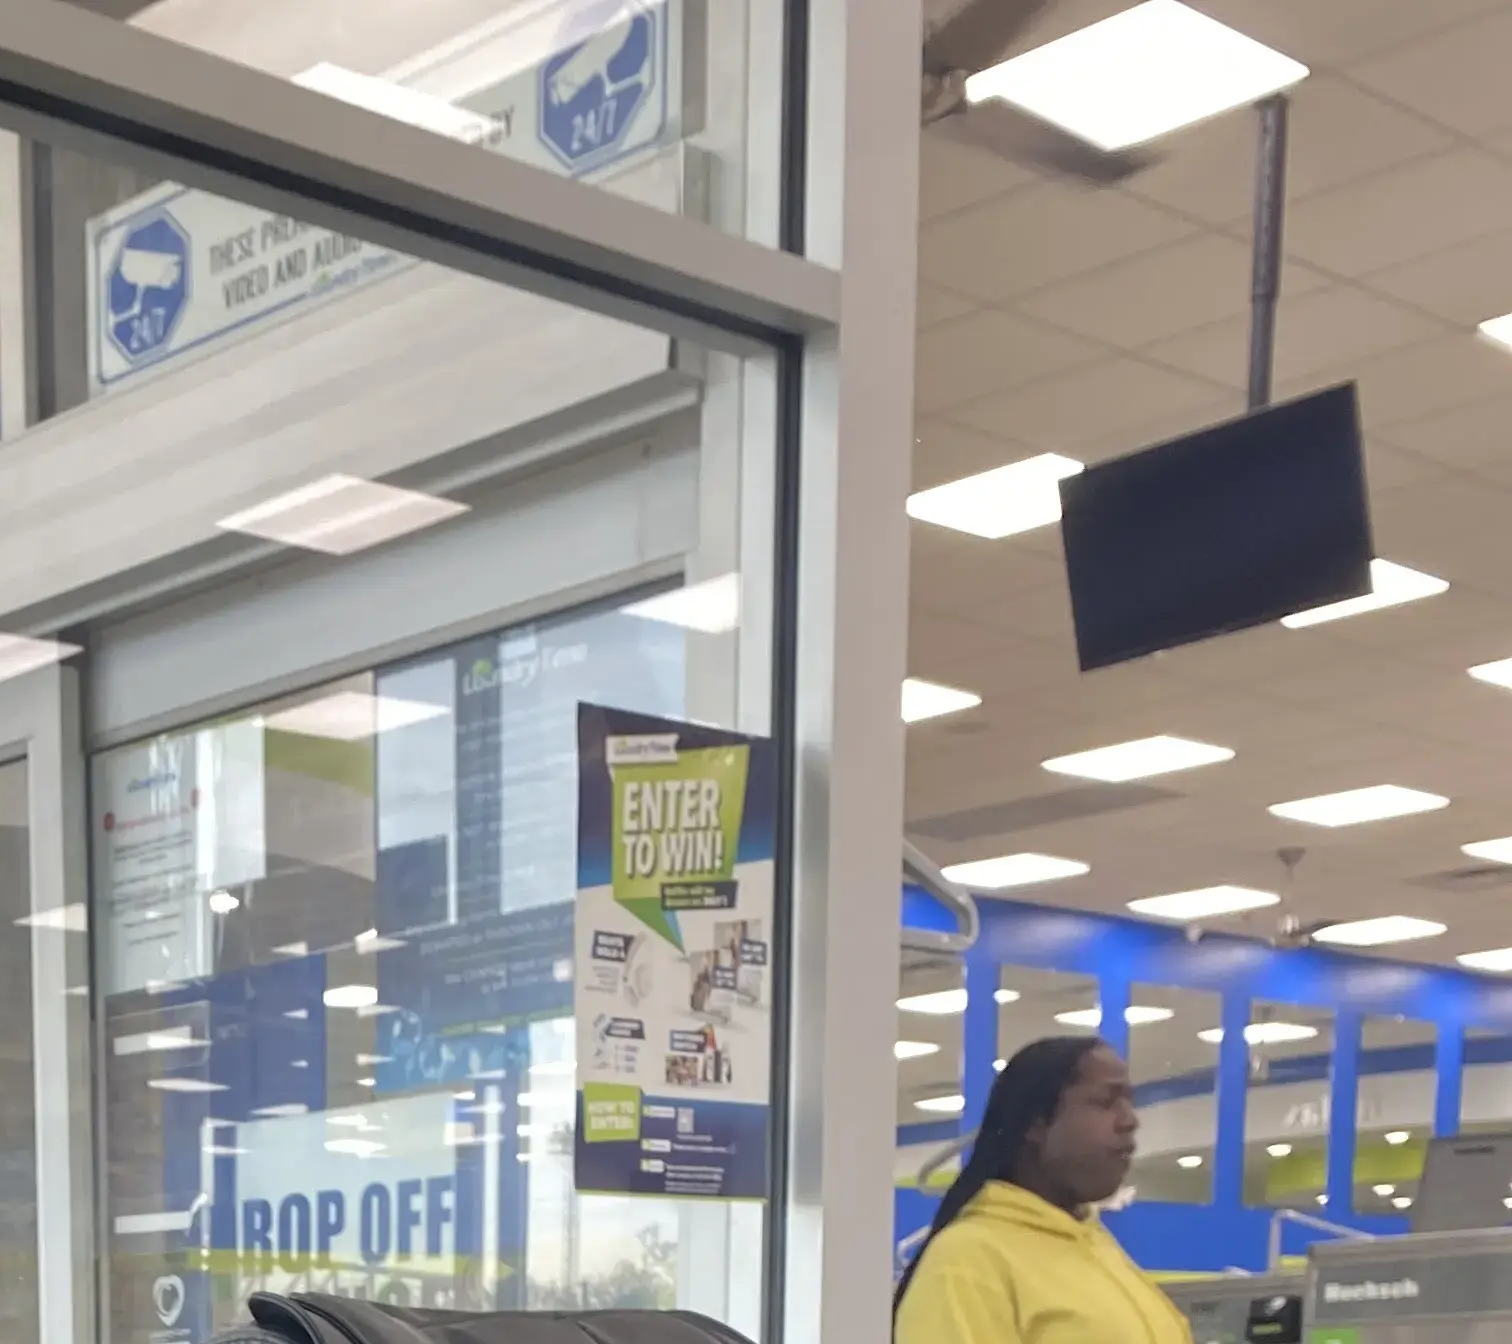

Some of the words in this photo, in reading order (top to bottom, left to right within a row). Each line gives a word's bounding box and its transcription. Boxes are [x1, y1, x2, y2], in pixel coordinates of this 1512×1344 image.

[622, 778, 721, 832] ENTER
[621, 834, 656, 876] TO
[659, 830, 724, 873] WIN!
[359, 1173, 456, 1267] OFF
